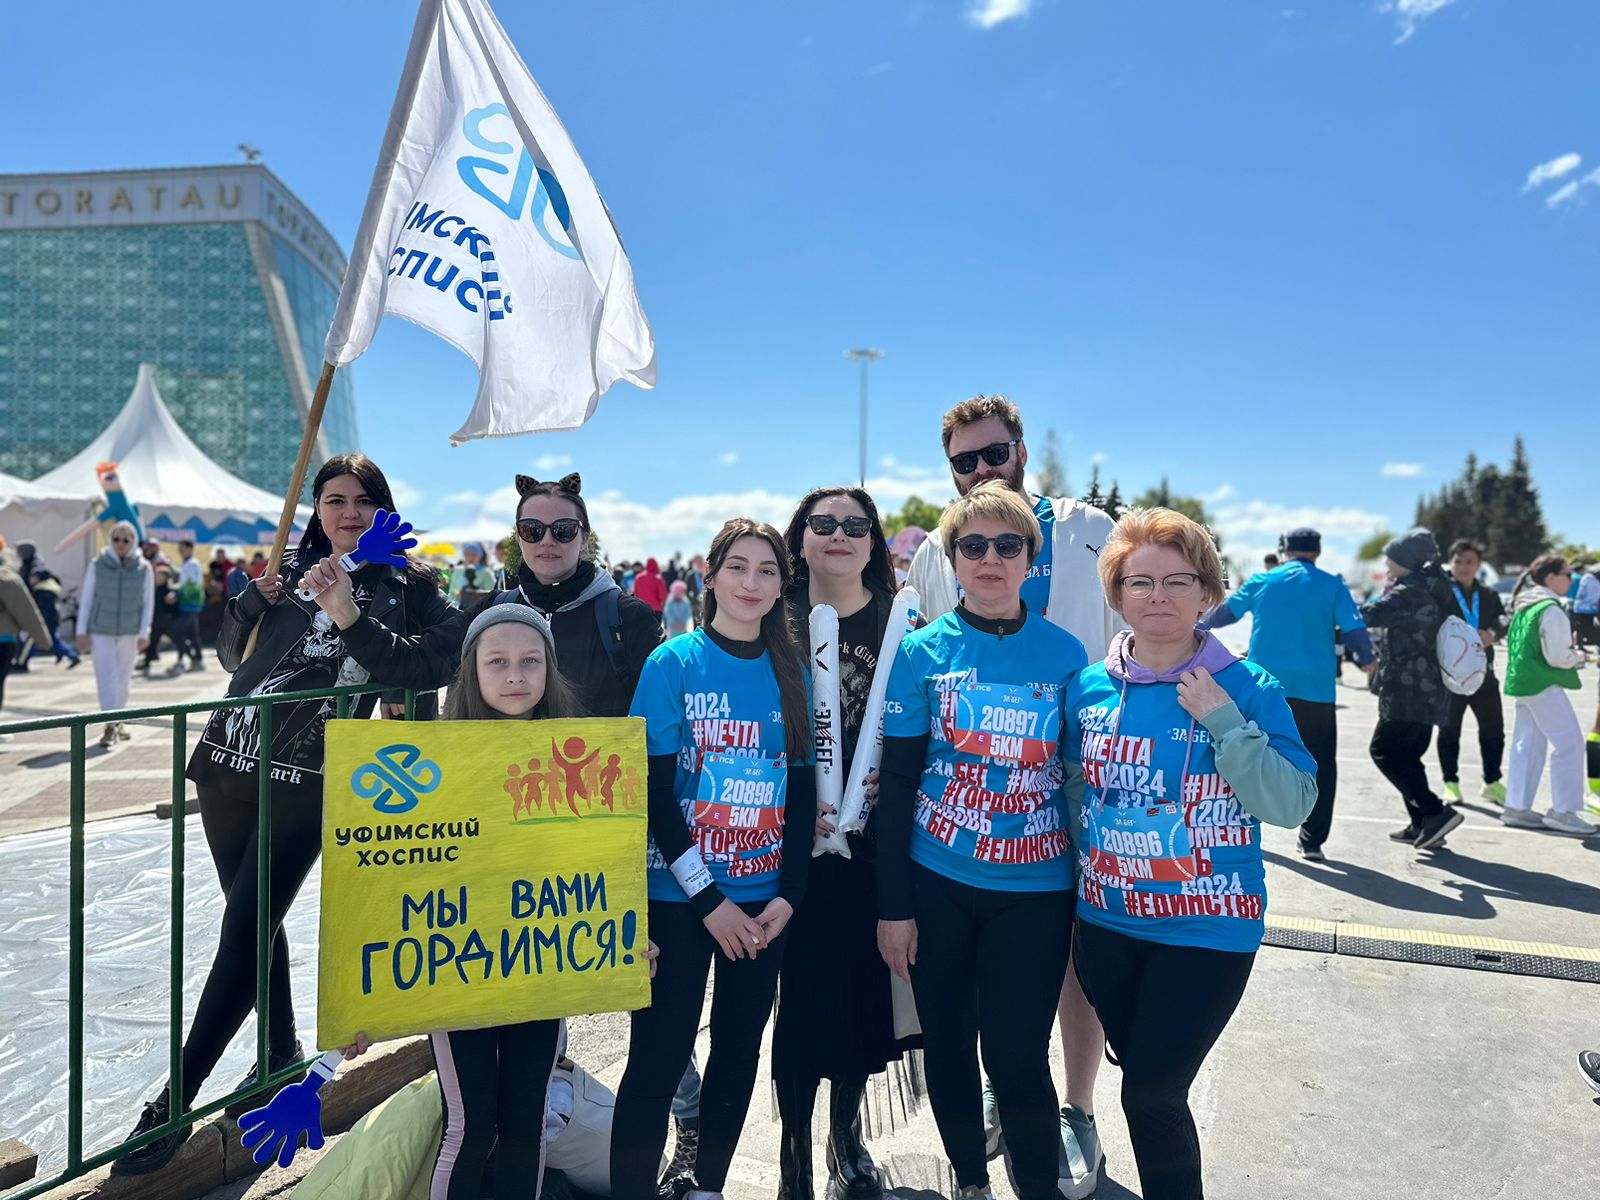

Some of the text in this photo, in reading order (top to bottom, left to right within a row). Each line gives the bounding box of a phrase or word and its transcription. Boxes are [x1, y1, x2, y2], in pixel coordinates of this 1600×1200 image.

[2, 182, 241, 217] TORATAU
[684, 692, 731, 720] 2024
[1078, 706, 1119, 733] 2024
[691, 719, 761, 748] #МЕЧТА
[980, 705, 1038, 737] 20897
[989, 734, 1024, 759] 5KM
[229, 755, 255, 773] the
[270, 766, 302, 785] ark
[1105, 762, 1166, 797] 2024
[720, 778, 775, 806] 20898
[729, 806, 761, 828] 5KM
[1024, 806, 1060, 836] 2024
[1198, 798, 1254, 826] 2024
[1101, 826, 1163, 857] 20896
[1116, 855, 1153, 879] 5KM
[401, 871, 607, 932] МЫ ВАМИ
[1122, 891, 1262, 920] #ЕДИНСТВО
[361, 909, 637, 995] ГОРДИМСЯ!
